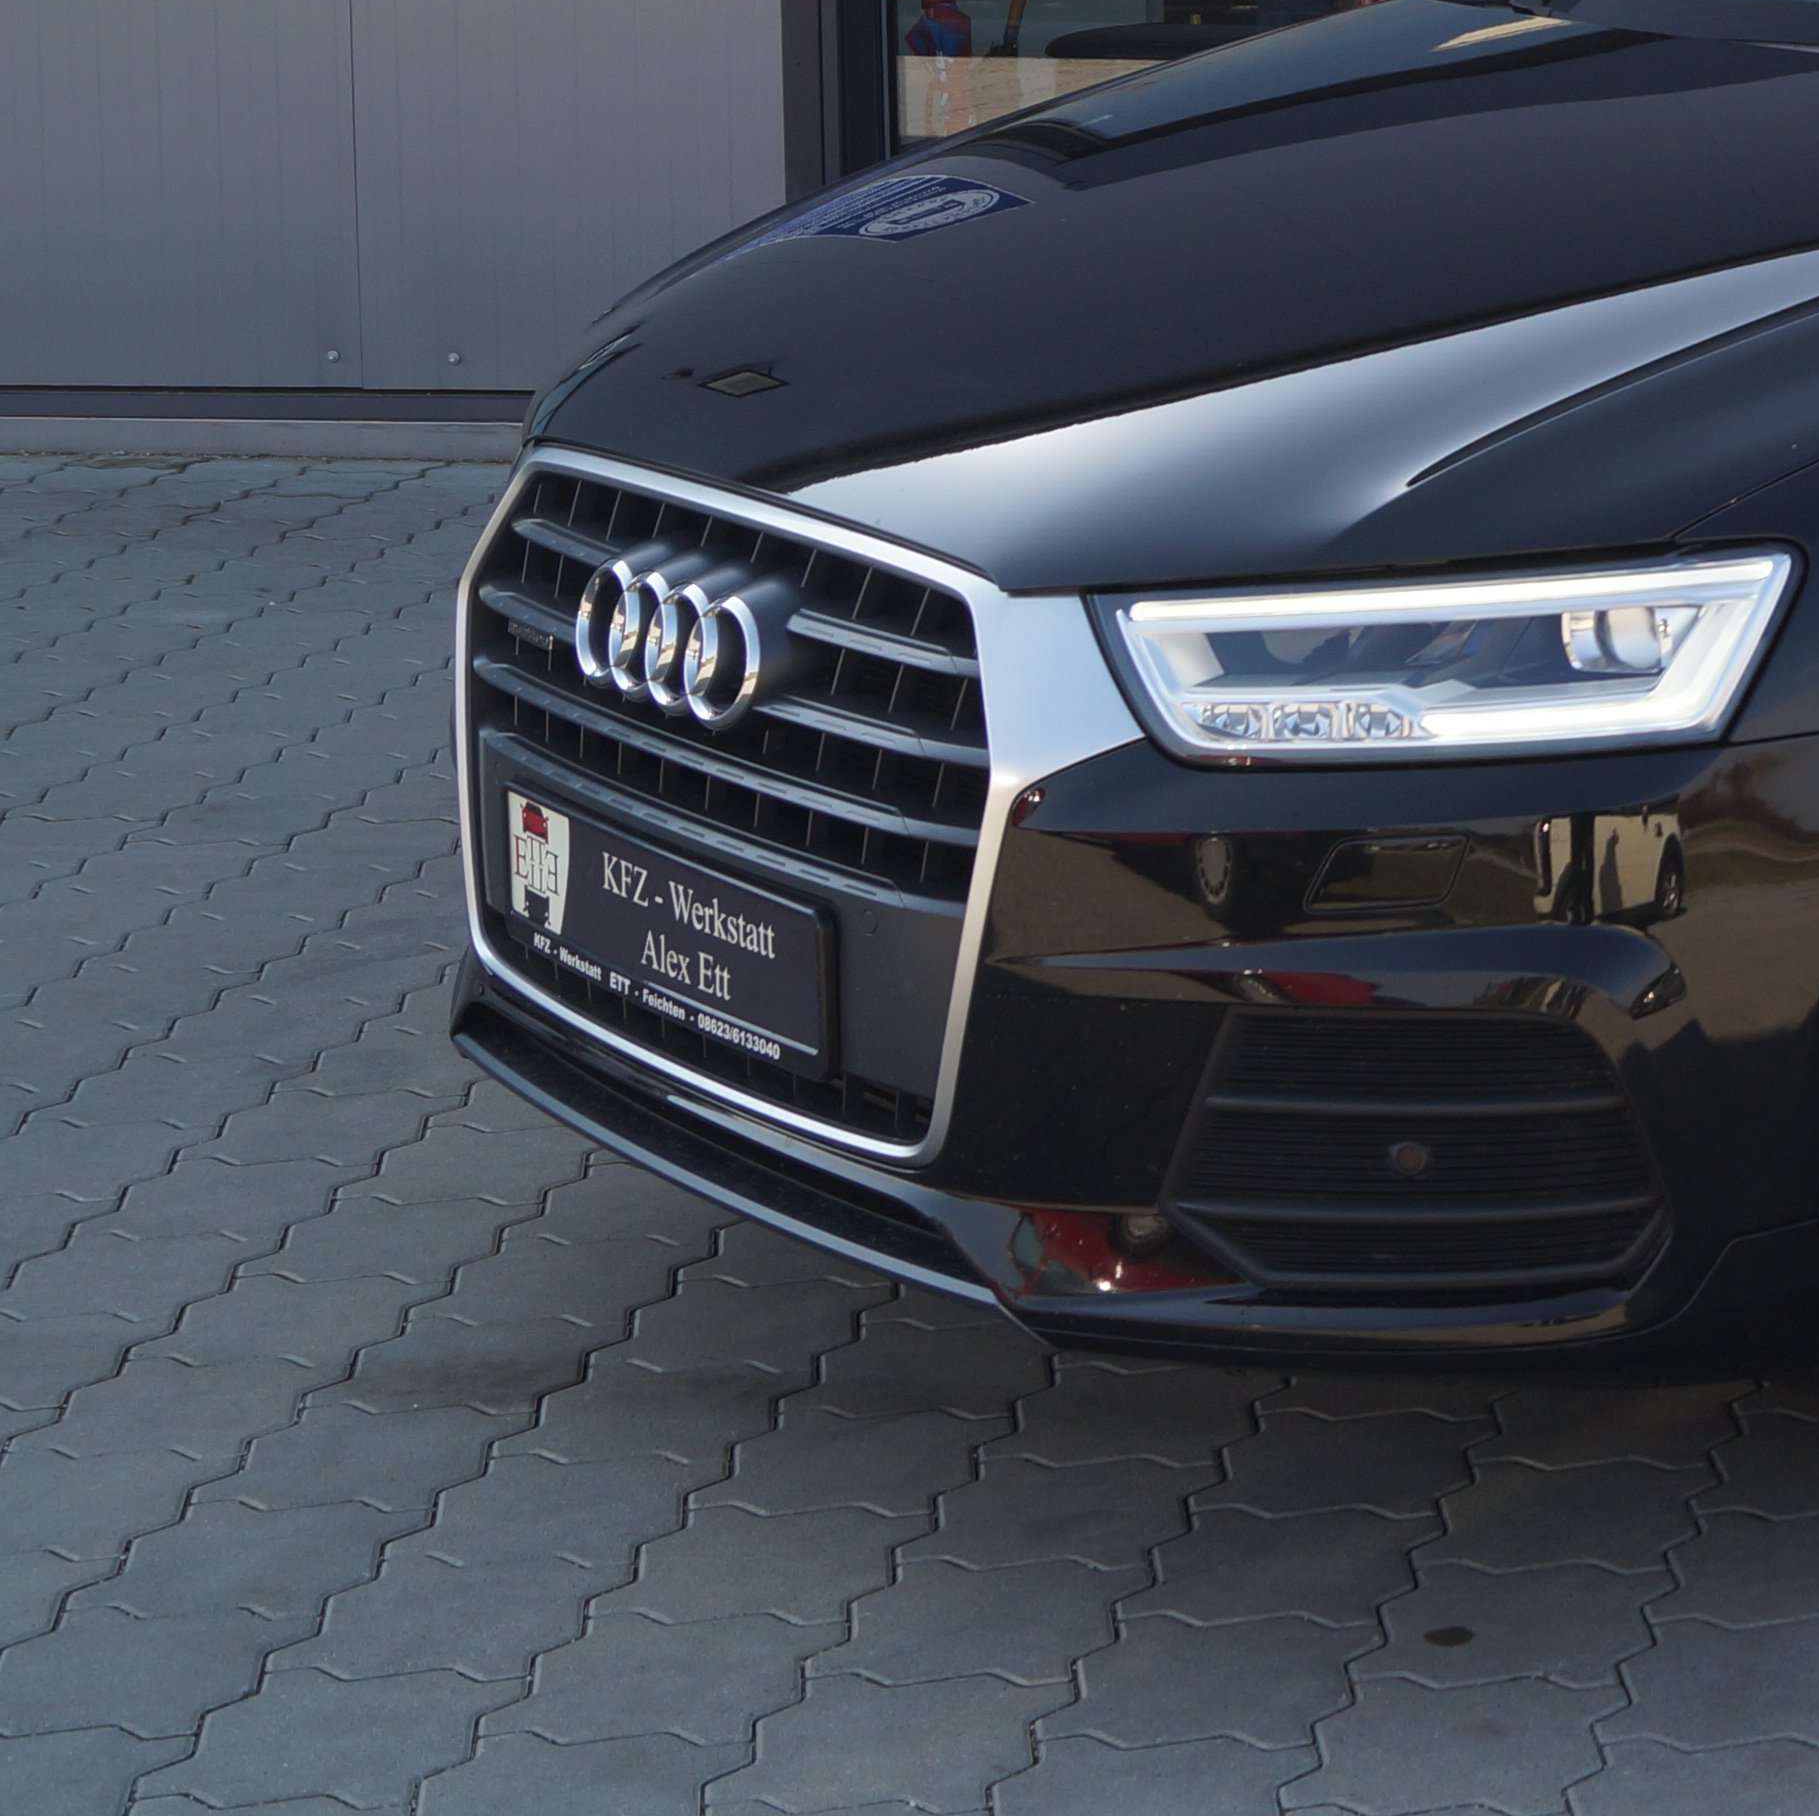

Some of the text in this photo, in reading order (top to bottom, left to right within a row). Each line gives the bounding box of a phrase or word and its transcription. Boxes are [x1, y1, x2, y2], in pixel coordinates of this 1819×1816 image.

[602, 851, 649, 907] KFZ
[669, 881, 776, 959] Werkstatt
[533, 932, 551, 954] KFZ
[559, 946, 602, 981] Werkstatt
[609, 971, 631, 995] ETT
[642, 989, 685, 1021] Feichten
[697, 1013, 781, 1060] 08623/6133040
[640, 930, 732, 1001] Alex Ett
